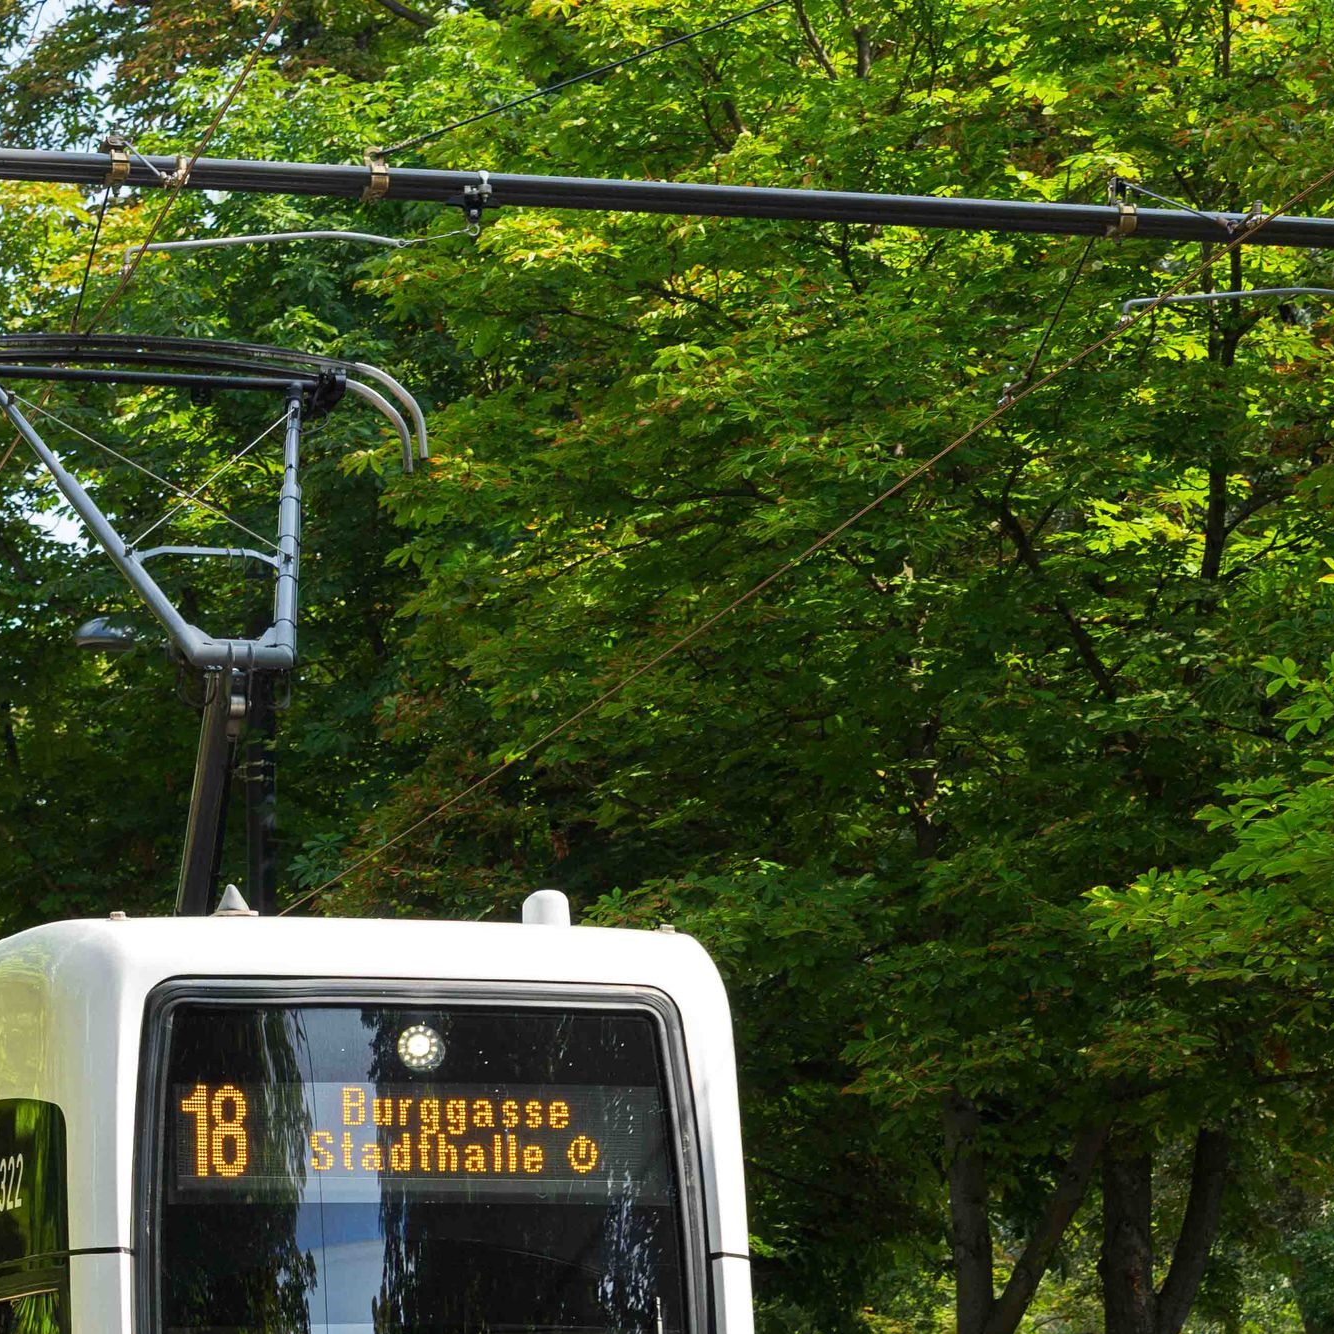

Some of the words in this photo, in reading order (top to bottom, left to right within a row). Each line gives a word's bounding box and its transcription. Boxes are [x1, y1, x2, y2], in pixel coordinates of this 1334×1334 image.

[181, 1084, 247, 1177] 18
[342, 1086, 571, 1135] Burggasse
[310, 1131, 544, 1173] Stadthalle
